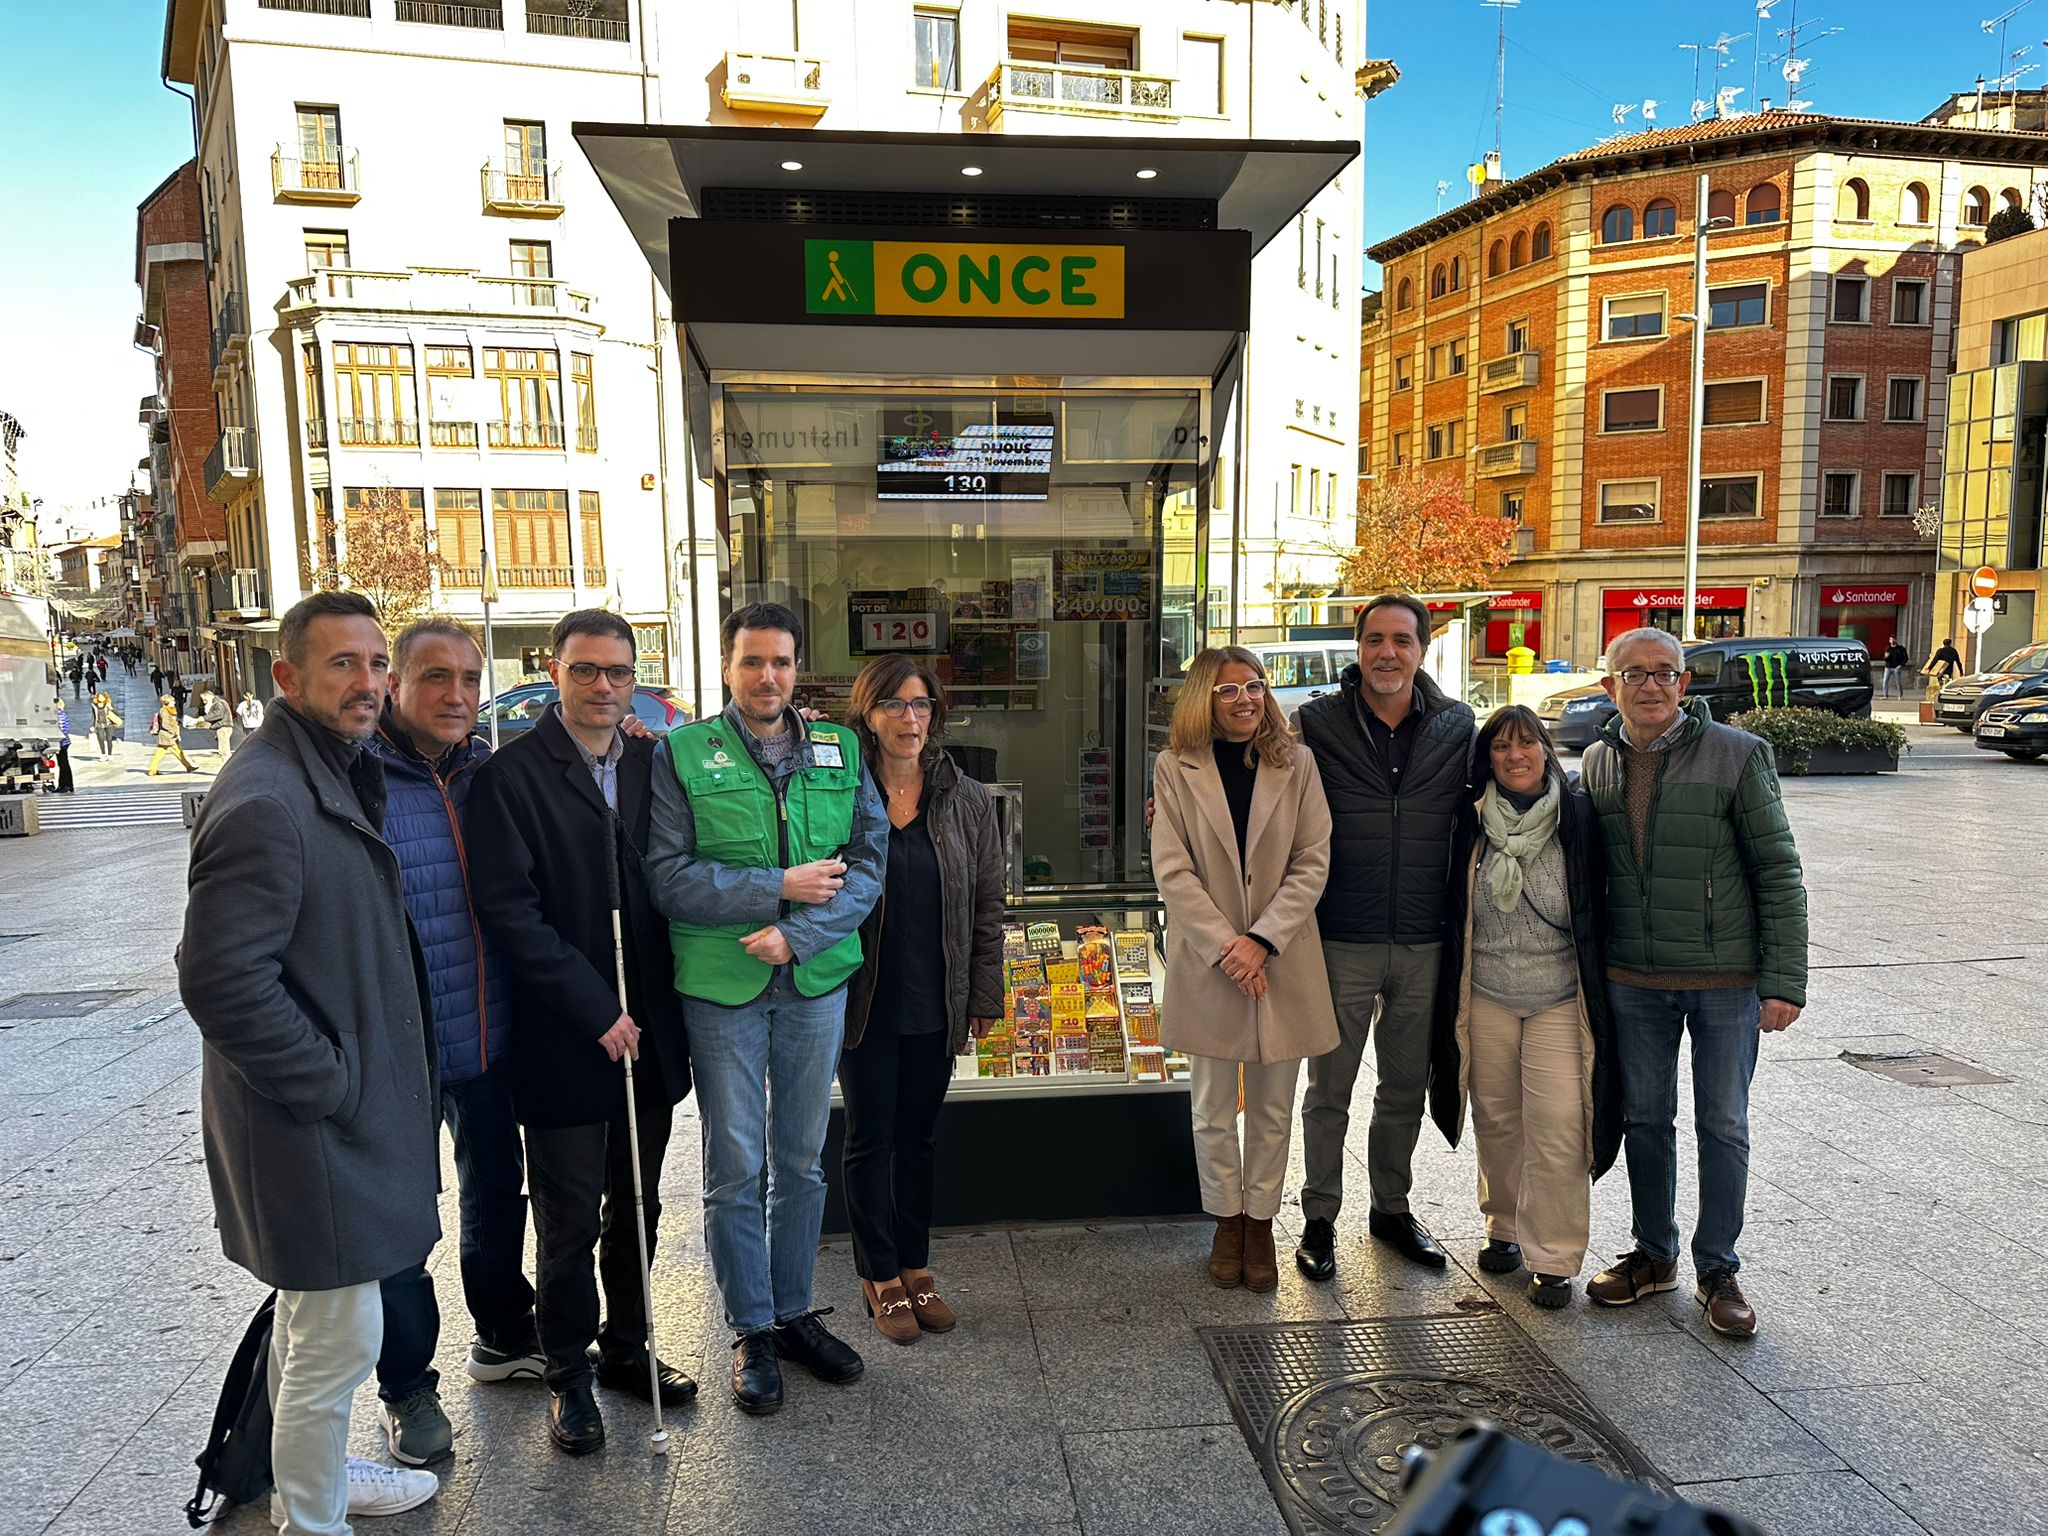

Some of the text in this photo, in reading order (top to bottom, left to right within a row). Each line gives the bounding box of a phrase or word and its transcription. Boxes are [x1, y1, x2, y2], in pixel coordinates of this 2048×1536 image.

[901, 253, 1097, 306] ONCE
[980, 442, 1032, 454] DIJOUS
[984, 456, 1045, 467] Novembre
[943, 474, 987, 492] 130
[1062, 554, 1107, 563] VENUT
[1496, 597, 1531, 607] Santander
[1649, 594, 1715, 607] Santader
[1845, 590, 1897, 602] Santander
[872, 620, 929, 641] 120
[1799, 650, 1866, 663] MONSTER
[811, 732, 837, 742] ONCE
